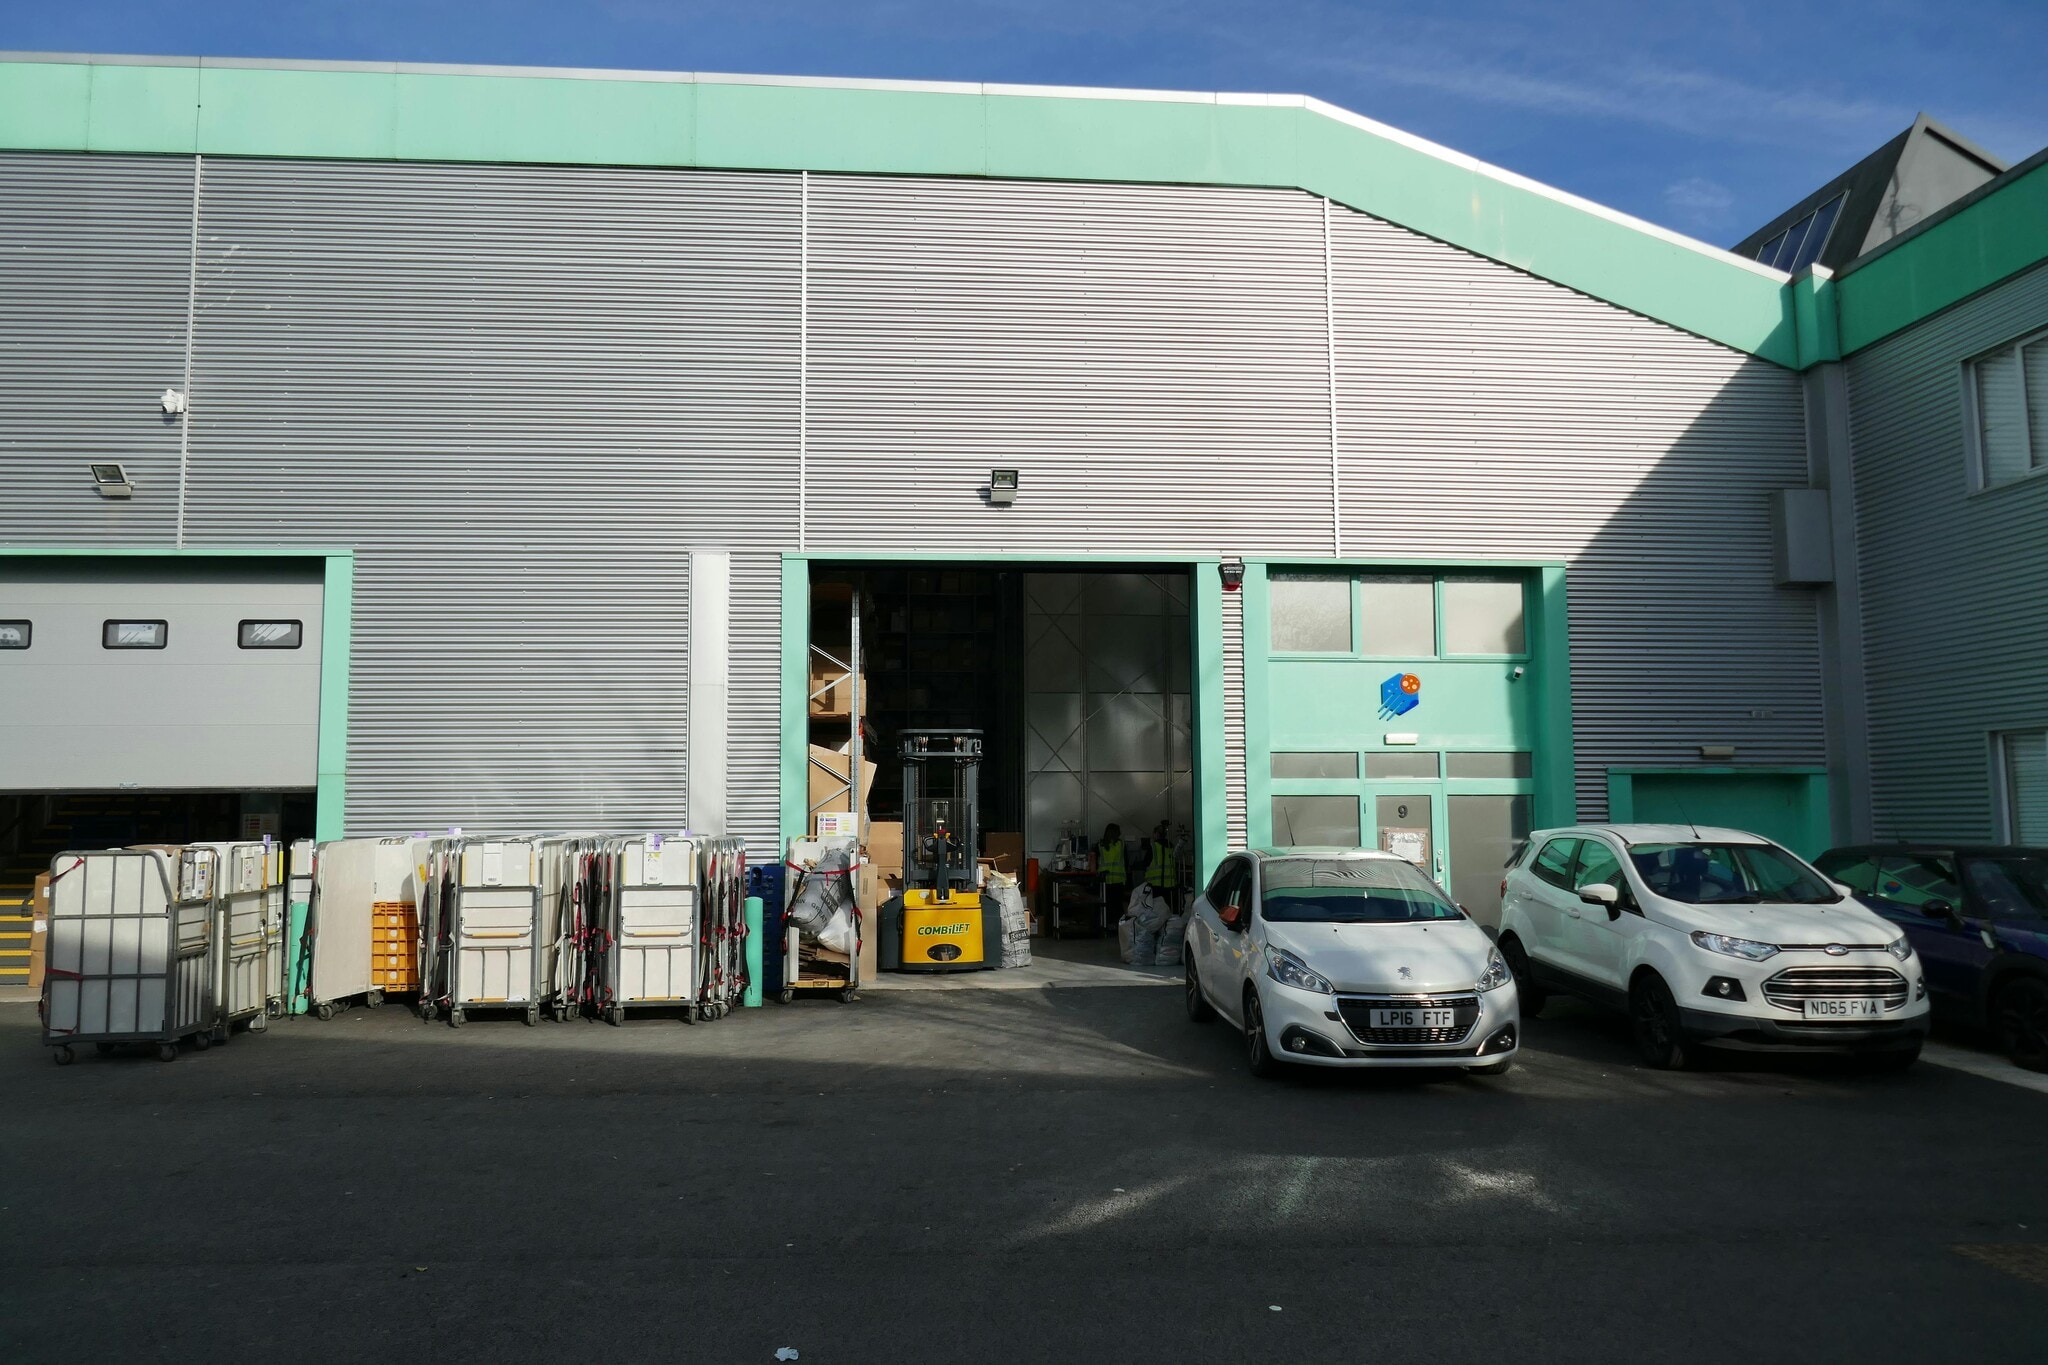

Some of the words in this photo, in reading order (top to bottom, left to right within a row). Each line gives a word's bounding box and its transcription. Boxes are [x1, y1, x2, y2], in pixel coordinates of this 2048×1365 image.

[1398, 804, 1408, 818] 9
[1811, 1001, 1847, 1015] ND65
[1851, 1001, 1878, 1014] FVA
[1380, 1011, 1413, 1026] LP16
[1423, 1011, 1451, 1025] FTF
